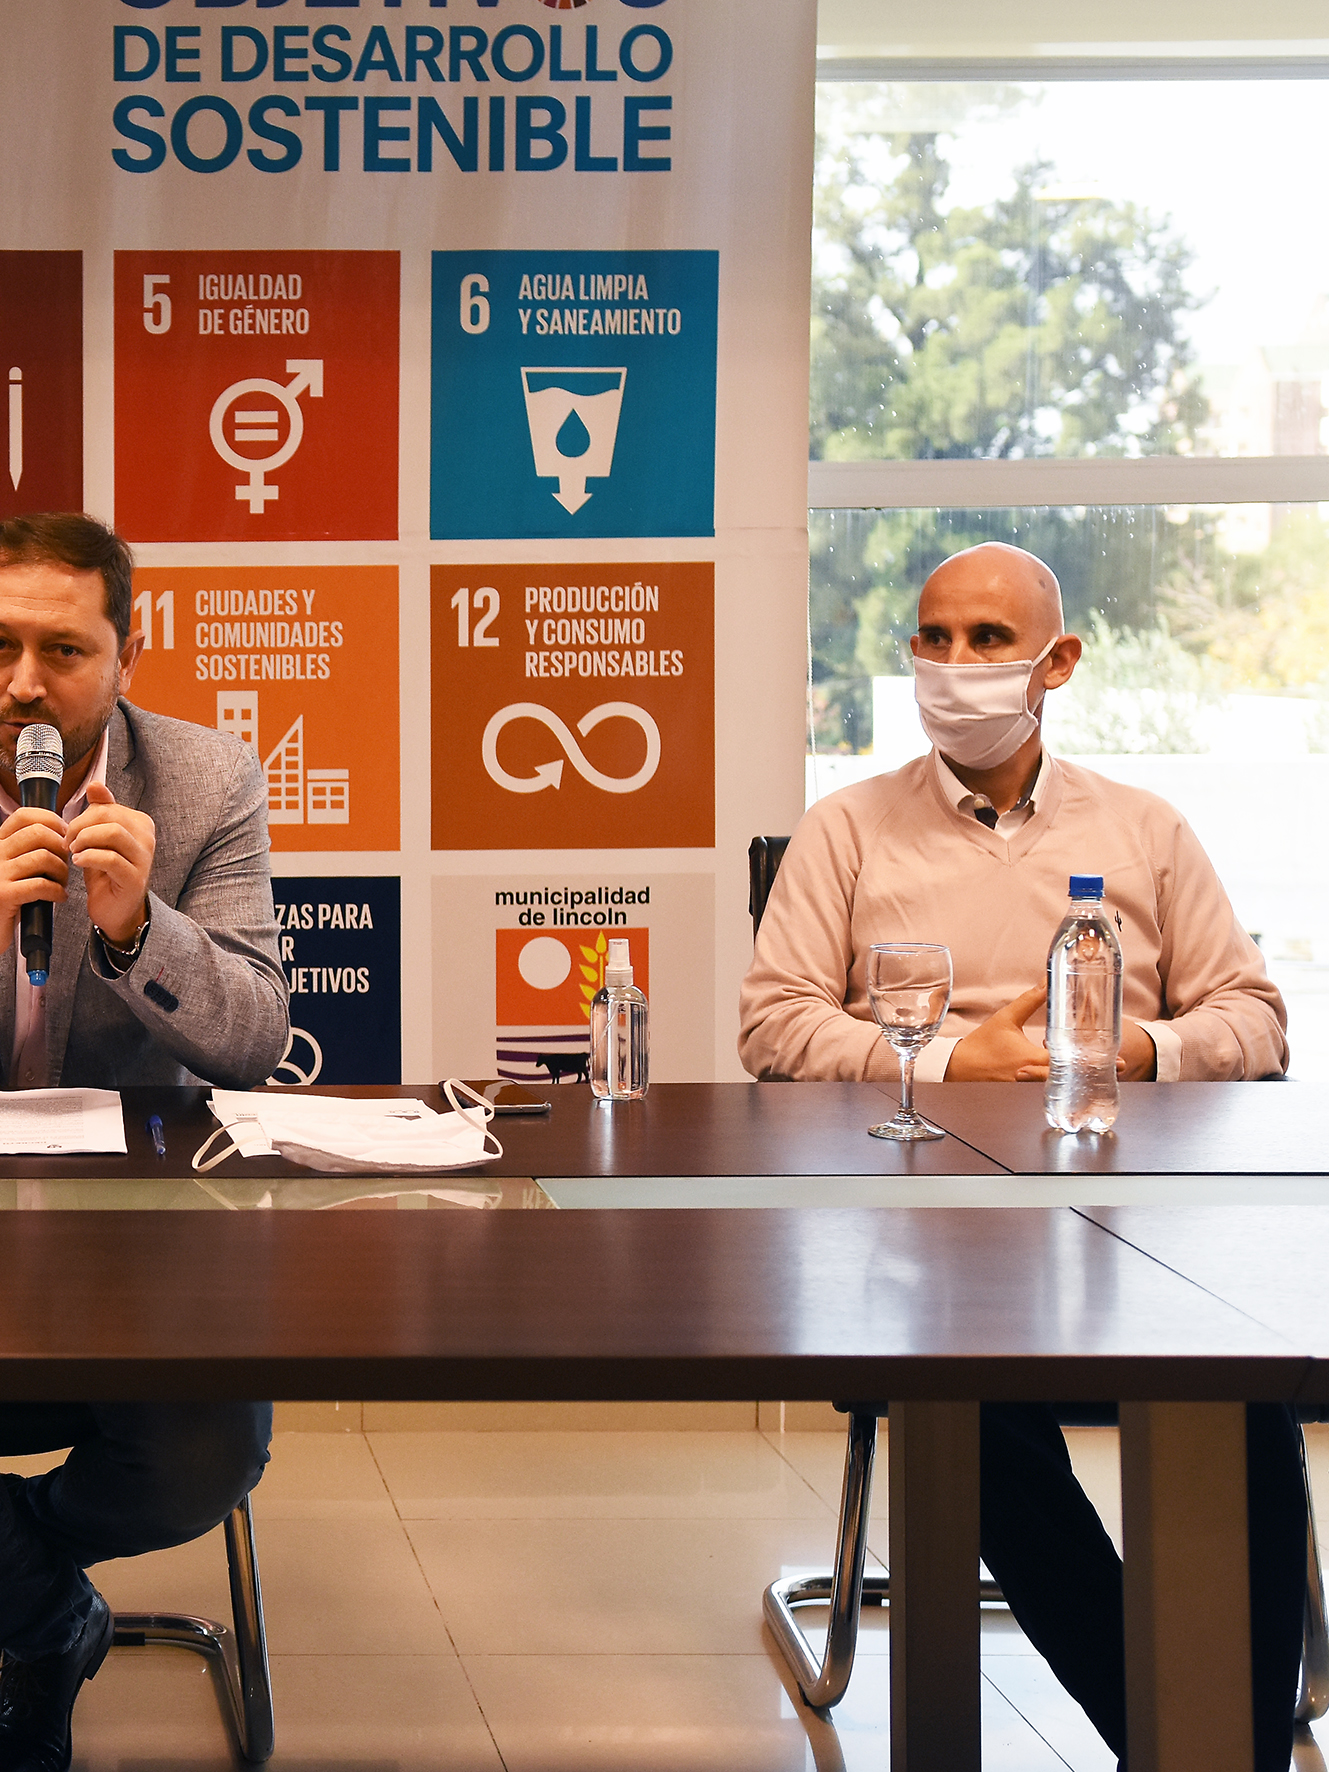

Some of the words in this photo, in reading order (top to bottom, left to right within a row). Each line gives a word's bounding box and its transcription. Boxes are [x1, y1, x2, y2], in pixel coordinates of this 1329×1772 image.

[113, 25, 202, 82] DE
[221, 24, 673, 83] DESARROLLO
[111, 94, 673, 174] SOSTENIBLE
[198, 274, 302, 300] IGUALDAD
[518, 274, 576, 301] AGUA
[579, 274, 649, 301] LIMPIA
[143, 274, 172, 335] 5
[460, 273, 491, 335] 6
[198, 309, 224, 335] DE
[229, 304, 310, 335] GÉNERO
[518, 308, 532, 335] Y
[536, 308, 682, 335] SANEAMIENTO
[195, 589, 298, 616] CIUDADES
[302, 589, 316, 616] Y
[525, 582, 659, 613] PRODUCCIÓN
[134, 590, 175, 650] 11
[451, 586, 501, 648] 12
[195, 621, 344, 648] COMUNIDADES
[525, 619, 539, 645] Y
[543, 618, 646, 646] CONSUMO
[195, 653, 331, 680] SOSTENIBLES
[525, 650, 684, 678] RESPONSABLES
[495, 886, 651, 909] municipalidad
[318, 903, 374, 930] PARA
[518, 908, 546, 926] de
[553, 907, 628, 926] lincoln
[289, 967, 370, 994] JETIVOS
